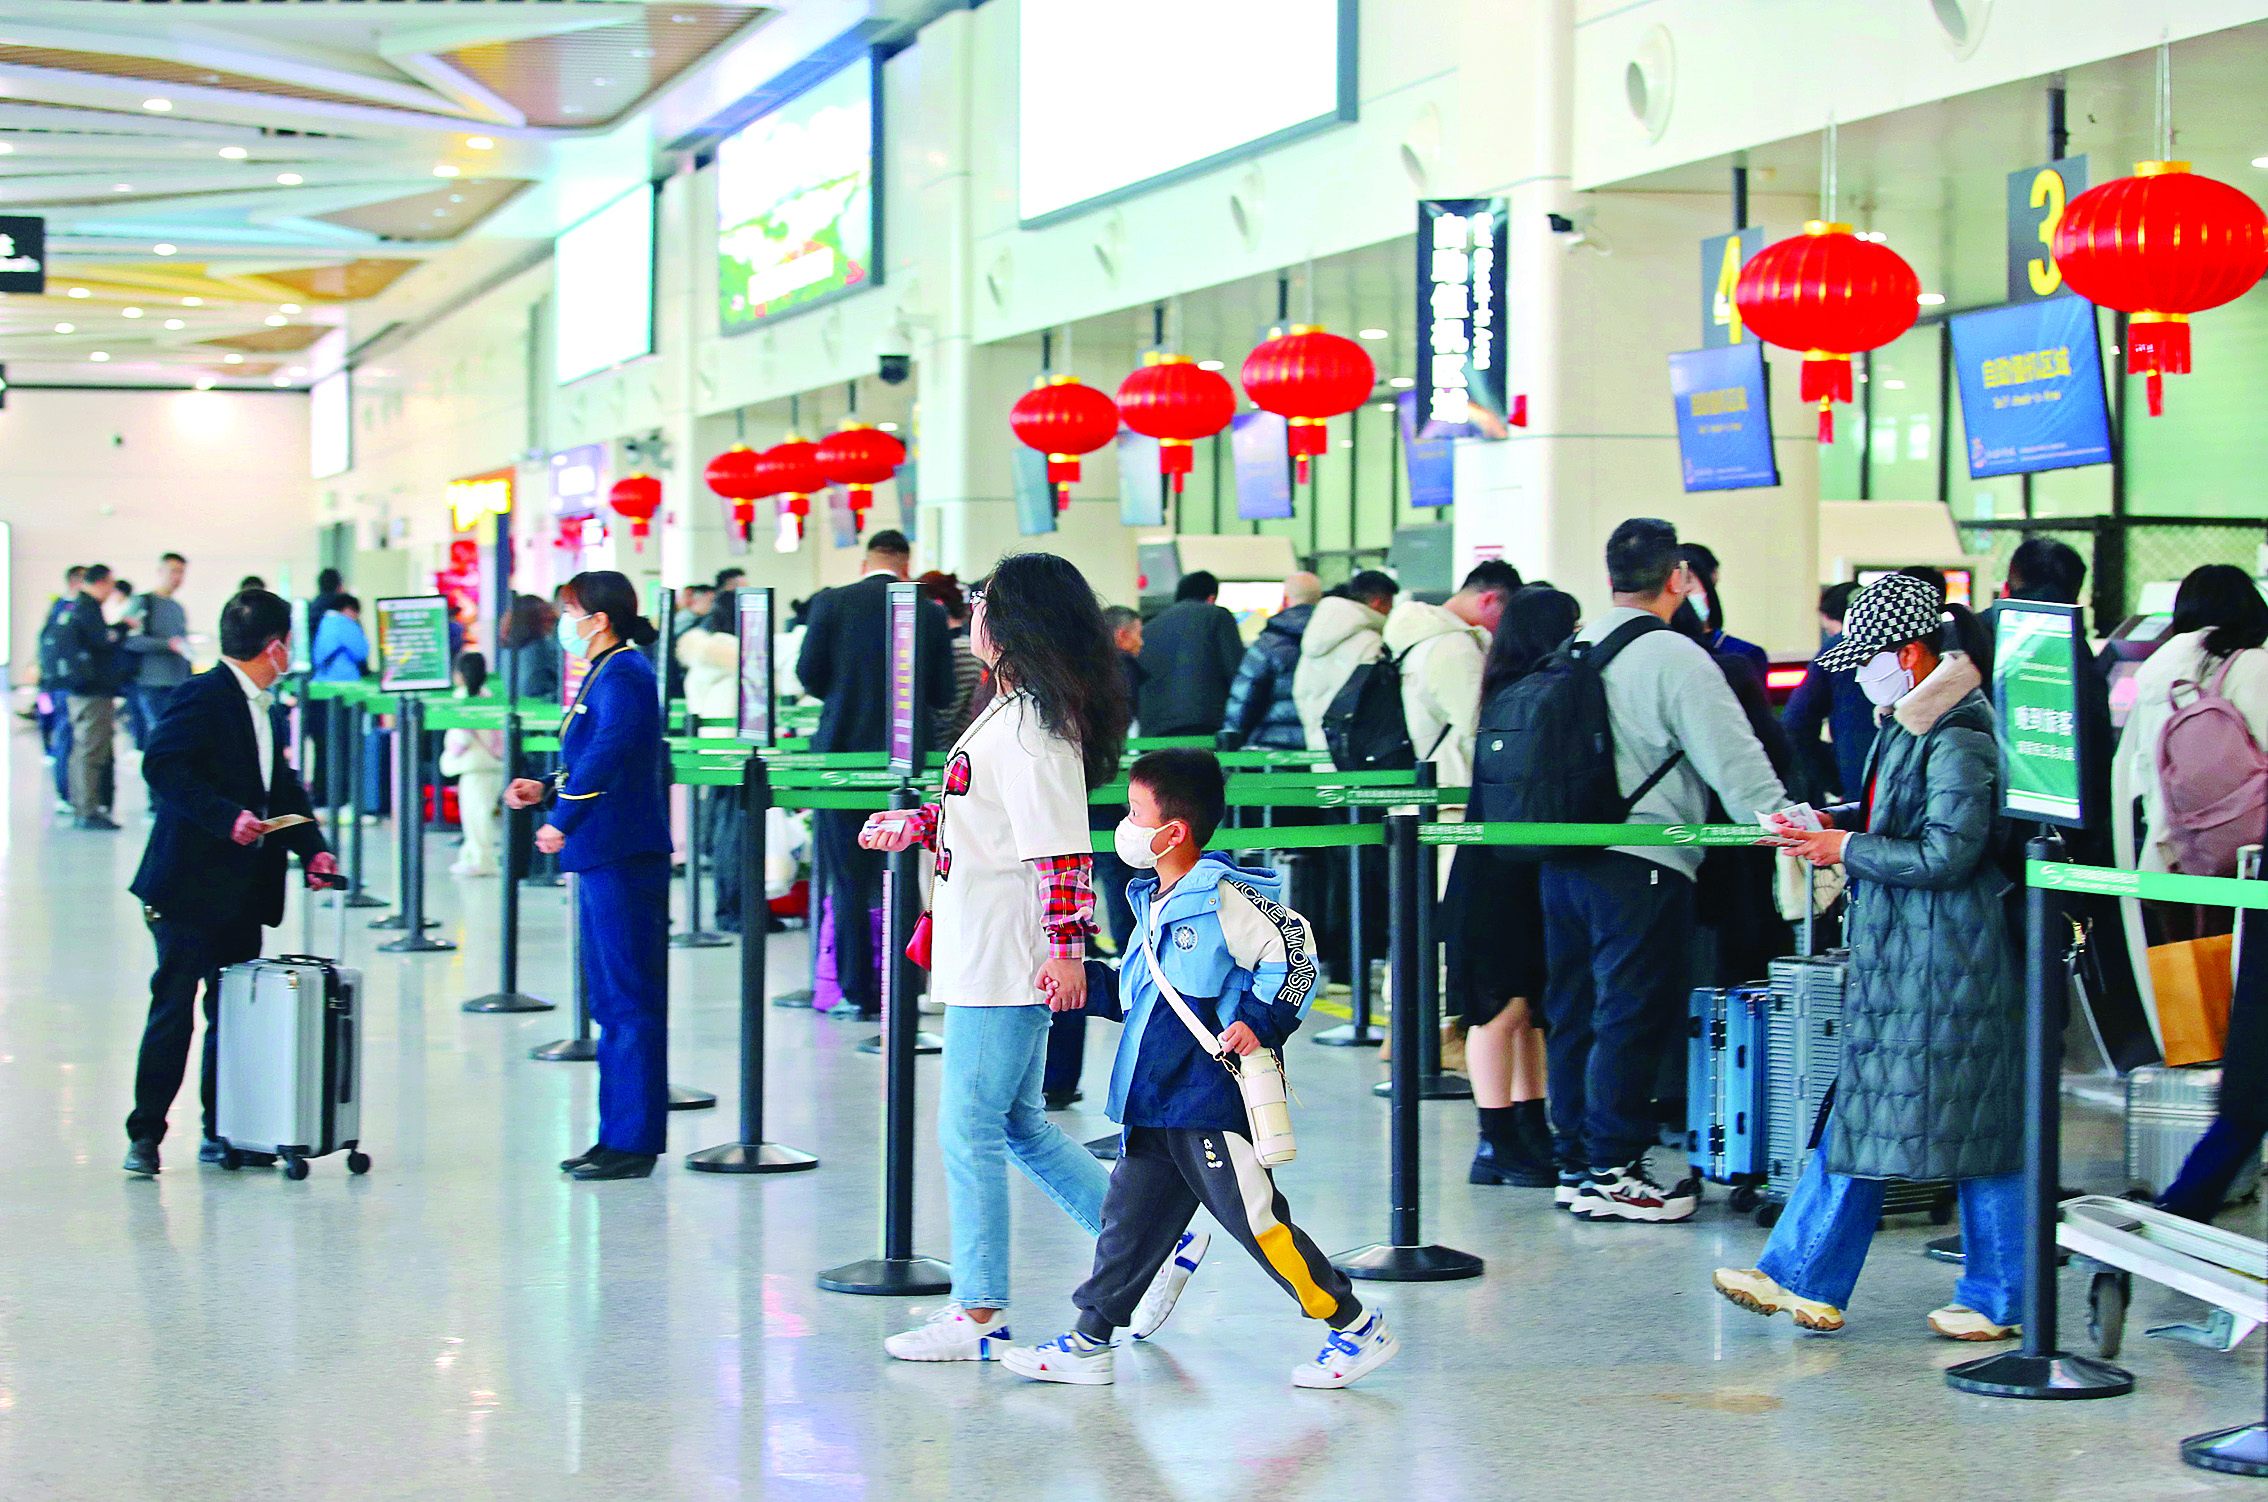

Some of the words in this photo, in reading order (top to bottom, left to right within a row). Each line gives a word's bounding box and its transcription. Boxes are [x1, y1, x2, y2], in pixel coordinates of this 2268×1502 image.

[2028, 169, 2065, 297] 3
[1713, 237, 1742, 345] 4
[1278, 926, 1315, 1007] MOUSE
